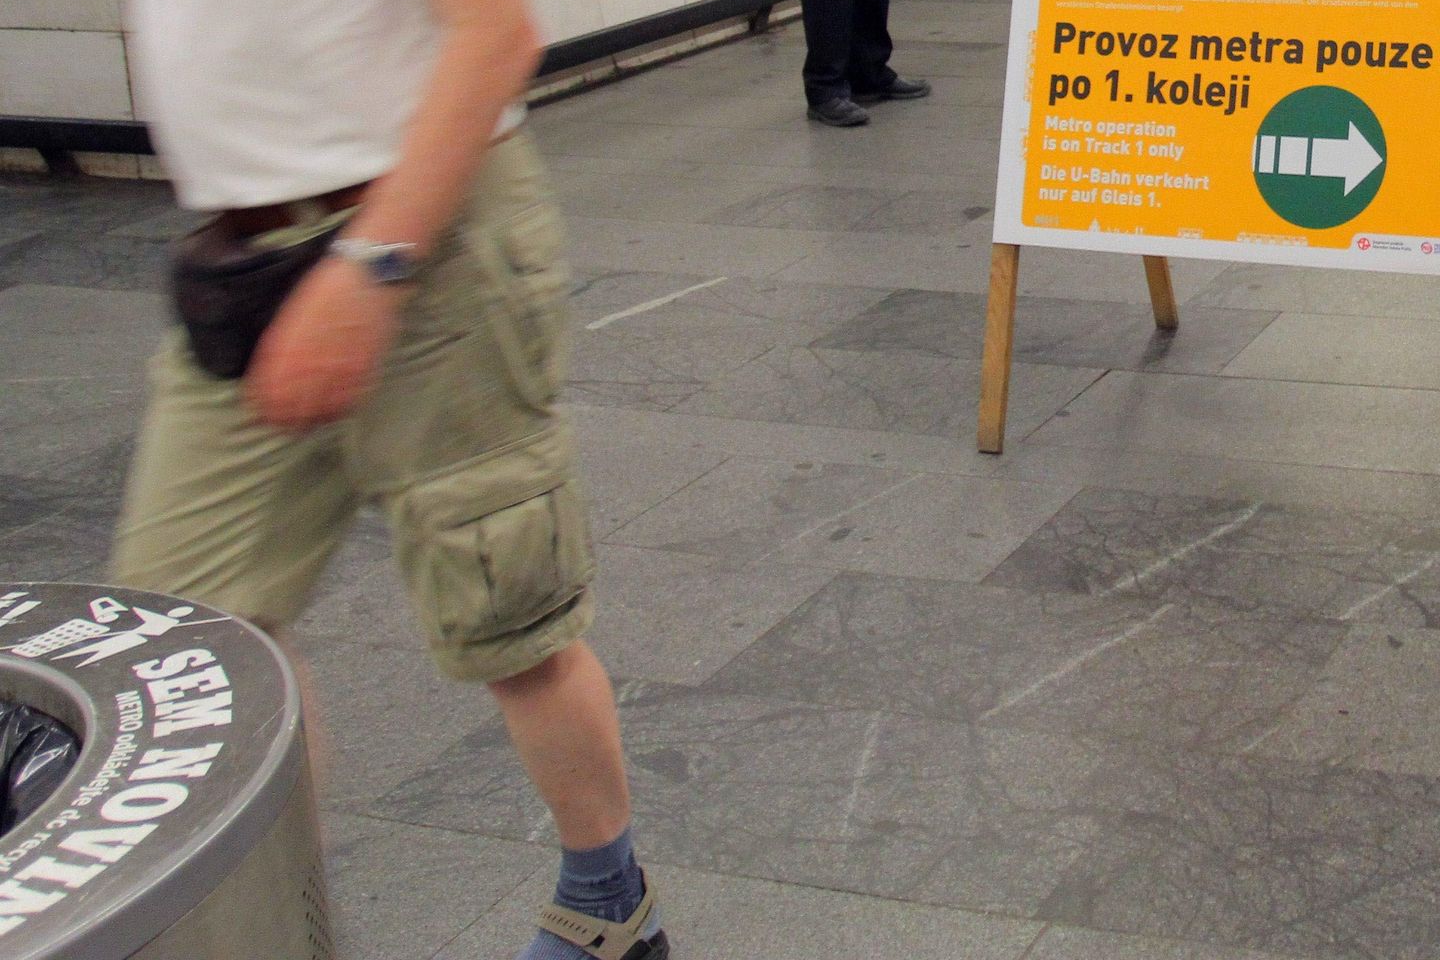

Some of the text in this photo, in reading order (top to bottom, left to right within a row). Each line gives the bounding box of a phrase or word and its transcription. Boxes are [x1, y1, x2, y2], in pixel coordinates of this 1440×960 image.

[1053, 22, 1434, 73] Provoz metra pouze
[1048, 69, 1250, 116] po 1. koleji
[1044, 115, 1177, 137] Metro operation
[1042, 135, 1184, 161] is on Track 1 only
[1040, 165, 1210, 191] Die U-Bahn verkehrt
[1039, 187, 1162, 208] nur auf Gleis 1.
[131, 647, 234, 738] SEM
[115, 690, 143, 732] METRO
